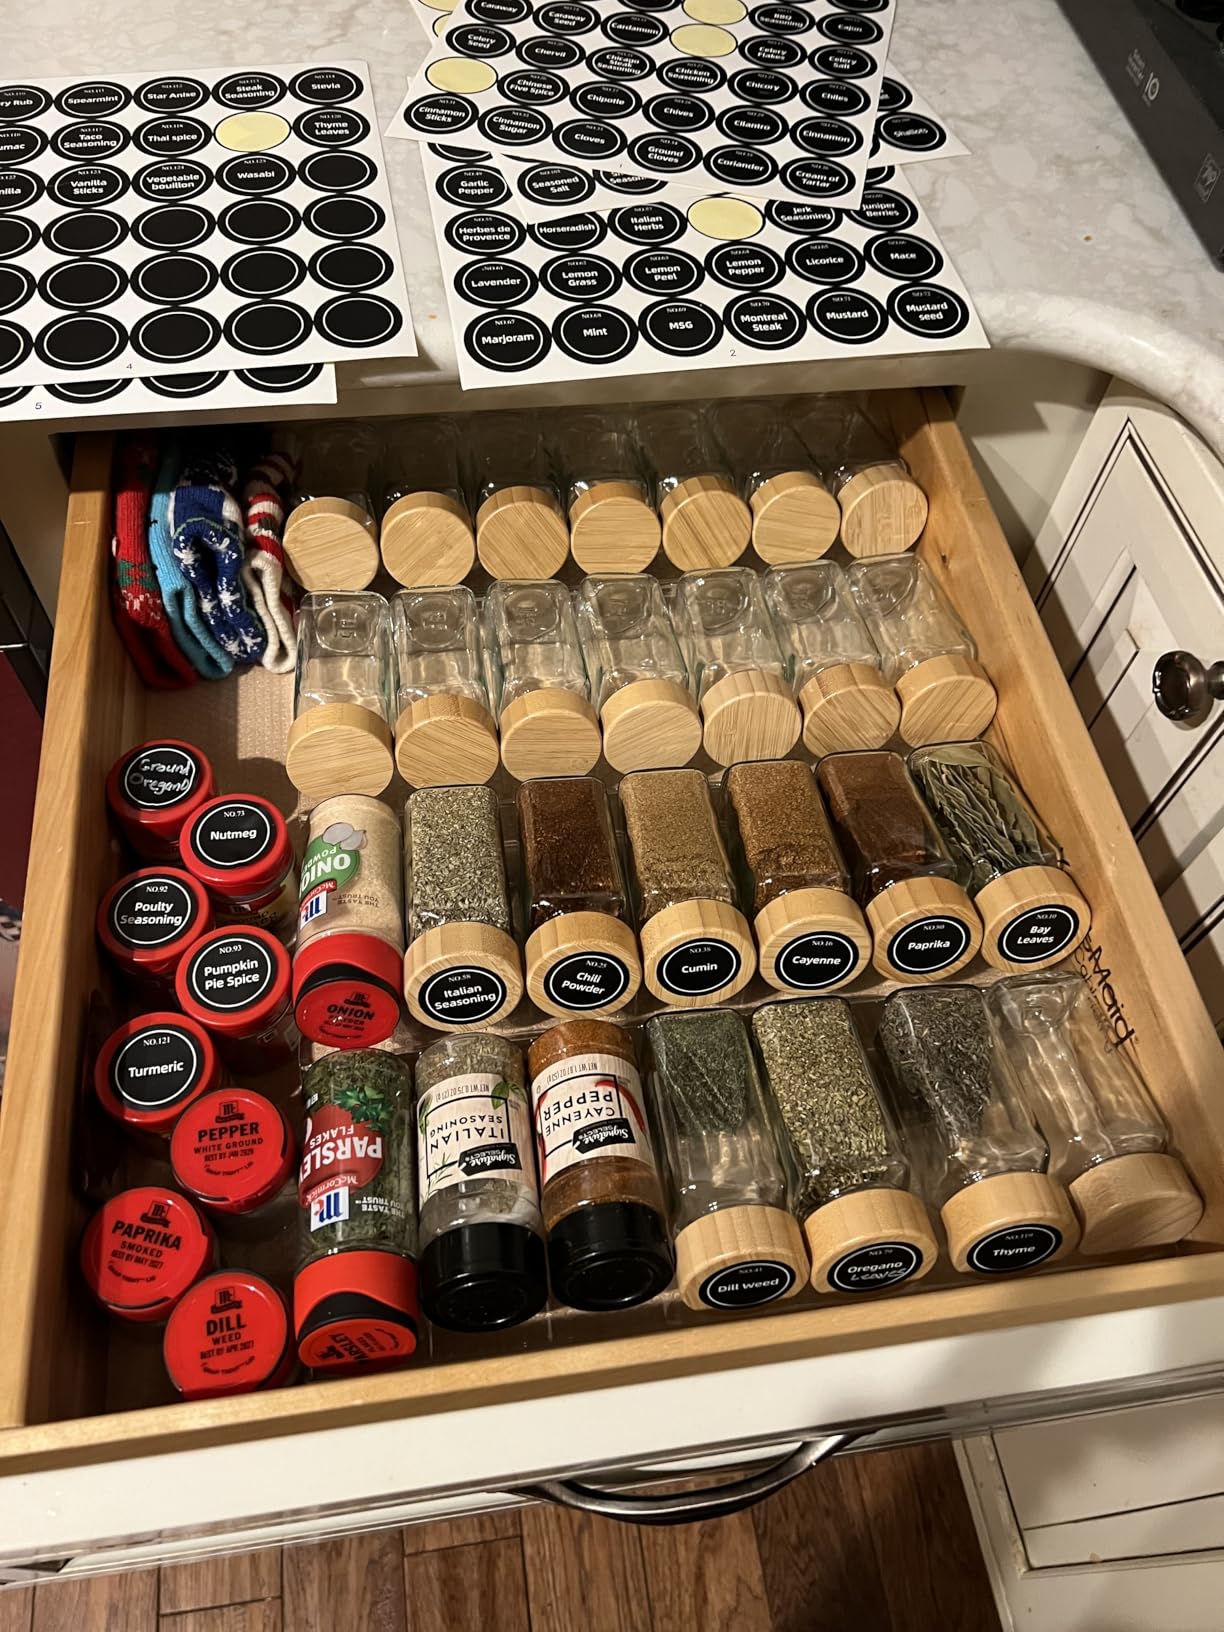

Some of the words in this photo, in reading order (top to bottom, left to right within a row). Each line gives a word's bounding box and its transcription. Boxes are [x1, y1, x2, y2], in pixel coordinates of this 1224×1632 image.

[467, 34, 496, 44] Celery
[468, 40, 491, 48] Seed
[236, 84, 263, 92] Steak
[517, 79, 552, 89] Chinese
[746, 81, 780, 91] Chicory
[225, 90, 275, 99] Seasoning
[509, 84, 529, 92] Five
[530, 87, 554, 96] Spice
[68, 95, 118, 104] Spearmint
[147, 92, 167, 100] Star
[419, 106, 465, 118] Cinnamon
[664, 107, 693, 117] Chives
[425, 114, 452, 122] Sticks
[492, 116, 540, 130] Cinnamon
[314, 122, 348, 130] Thyme
[499, 124, 527, 134] Sugar
[734, 120, 770, 131] Cilantro
[172, 134, 198, 142] spice
[574, 133, 605, 144] Cloves
[64, 139, 117, 149] Seasoning
[648, 146, 684, 157] Ground
[647, 153, 679, 163] Cloves
[718, 158, 764, 172] Coriander
[146, 174, 200, 184] Vegetable
[237, 170, 275, 179] Wasabi
[796, 170, 827, 180] Cream
[70, 180, 107, 188] Vanilla
[152, 182, 195, 190] bouillon
[532, 176, 579, 188] Seasoned
[73, 187, 103, 195] Sticks
[458, 187, 494, 195] Pepper
[550, 185, 570, 193] Salt
[862, 202, 895, 211] Juniper
[630, 216, 663, 224] Italian
[780, 213, 831, 222] Seasoning
[539, 224, 595, 233] Horseradish
[634, 223, 664, 231] Herbs
[463, 234, 510, 242] Provence
[726, 258, 761, 267] Lemon
[806, 256, 844, 265] Licorice
[645, 265, 681, 274] Lemon
[728, 267, 765, 276] Pepper
[471, 278, 521, 287] Lavender
[906, 302, 948, 312] Mustard
[740, 312, 788, 323] Montreal
[826, 310, 869, 320] Mustard
[919, 312, 943, 321] seed
[669, 321, 693, 330] MSG
[752, 322, 782, 332] Steak
[583, 328, 608, 337] Mint
[481, 333, 535, 345] Marjoram
[223, 810, 245, 818] NO.73
[210, 829, 257, 841] Nutmeg
[134, 902, 173, 913] Poulty
[119, 914, 183, 926] Seasoning
[1029, 926, 1051, 935] Bay
[1017, 935, 1054, 944] Leaves
[219, 944, 242, 955] NO.93
[907, 939, 951, 951] Paprika
[792, 956, 841, 966] Cayenne
[203, 959, 259, 977] Pumpkin
[681, 962, 718, 974] Cumin
[205, 978, 225, 991] Pie
[227, 973, 260, 988] Spice
[576, 971, 602, 983] Chili
[444, 984, 483, 998] Italian
[561, 980, 605, 995] Powder
[434, 992, 497, 1010] Seasoning
[327, 1004, 375, 1020] ONION
[143, 1036, 171, 1047] NO.121
[128, 1060, 184, 1078] Turmeric
[543, 1091, 613, 1121] PEPPER
[430, 1115, 503, 1137] SEASONING
[545, 1107, 615, 1136] CAYENNE
[198, 1122, 259, 1142] PEPPER
[309, 1124, 354, 1148] FLAKES
[584, 1124, 629, 1145] Signature
[430, 1127, 504, 1154] ITALIAN
[194, 1143, 222, 1154] WHITE
[225, 1138, 263, 1149] GROUND
[470, 1149, 516, 1167] Signature
[112, 1221, 181, 1250] PAPRIKA
[121, 1241, 162, 1257] SMOKED
[993, 1245, 1036, 1257] Thyme
[848, 1261, 903, 1274] Oregano
[718, 1284, 740, 1293] Dill
[743, 1278, 780, 1290] Weed
[206, 1314, 247, 1337] DILL
[212, 1332, 241, 1345] WEED
